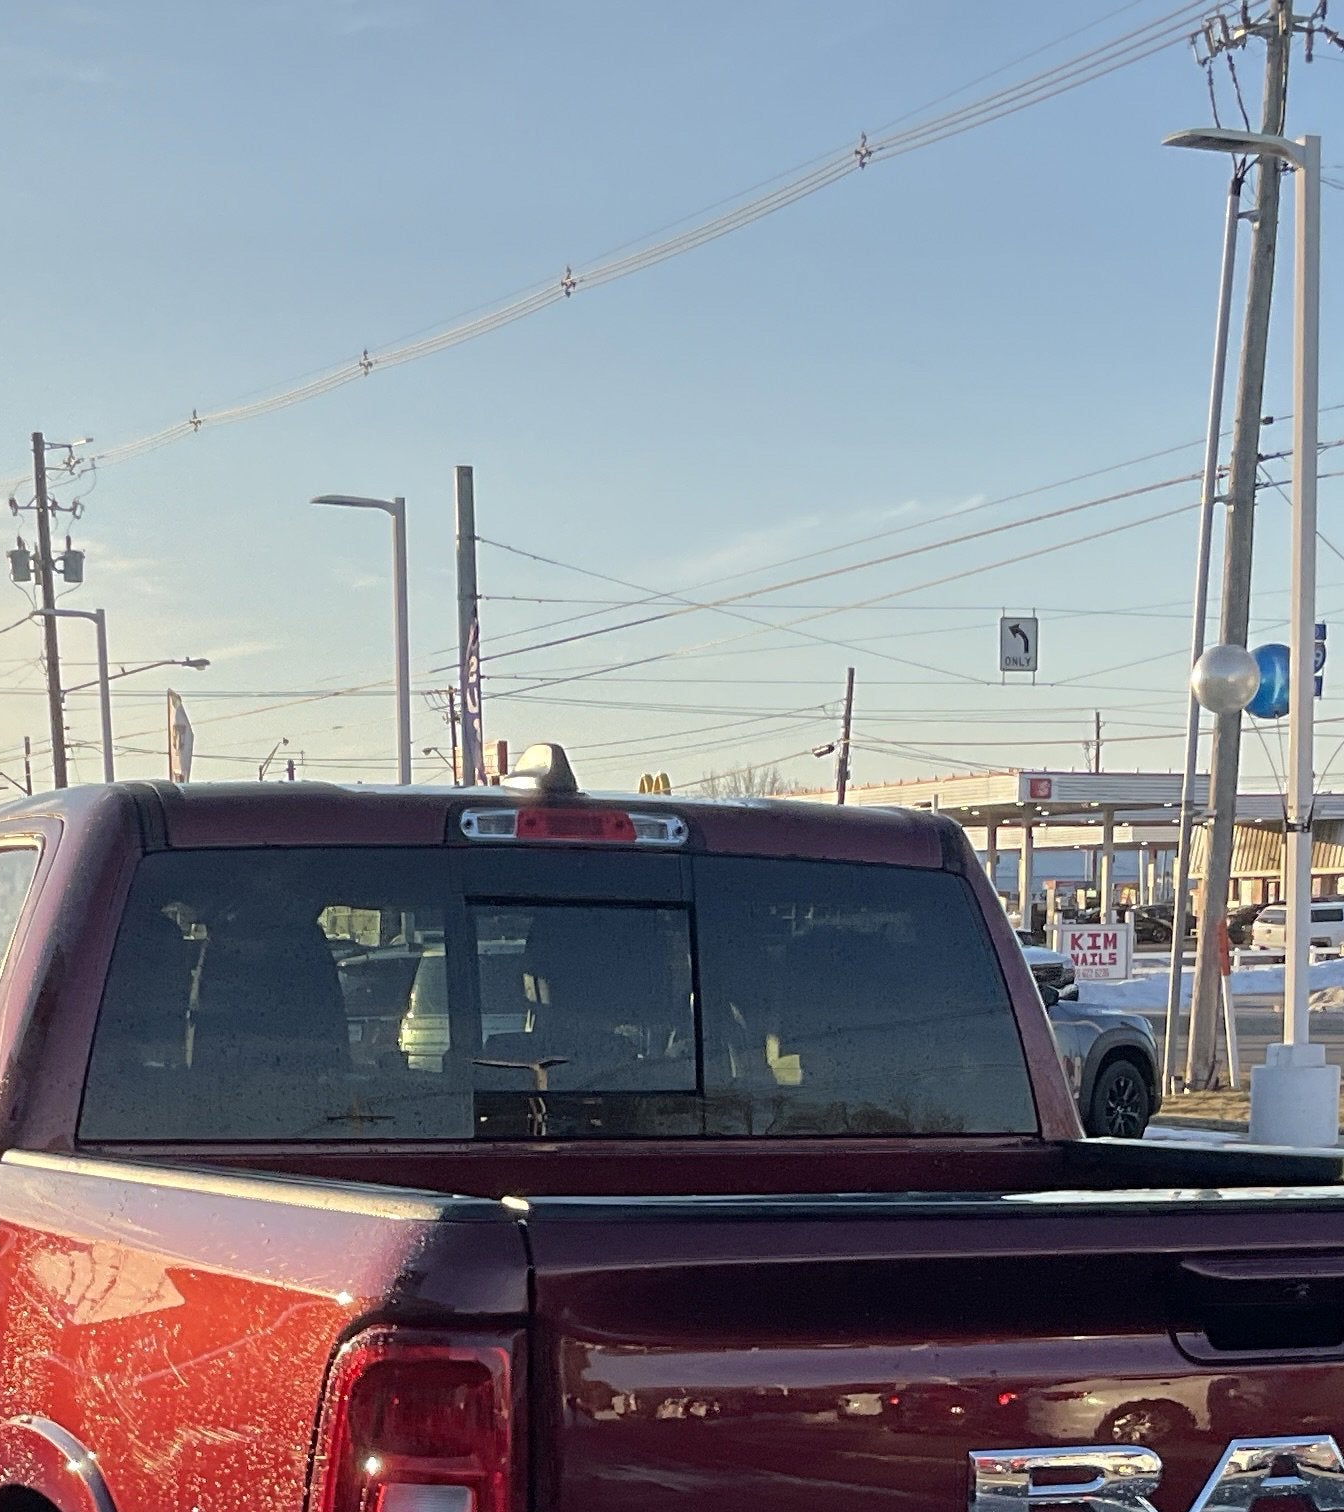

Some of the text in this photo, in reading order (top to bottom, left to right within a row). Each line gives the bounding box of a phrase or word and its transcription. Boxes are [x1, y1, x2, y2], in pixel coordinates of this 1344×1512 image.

[1004, 656, 1031, 667] ONLY
[1070, 933, 1117, 950] KIM
[1071, 952, 1117, 966] NAILS
